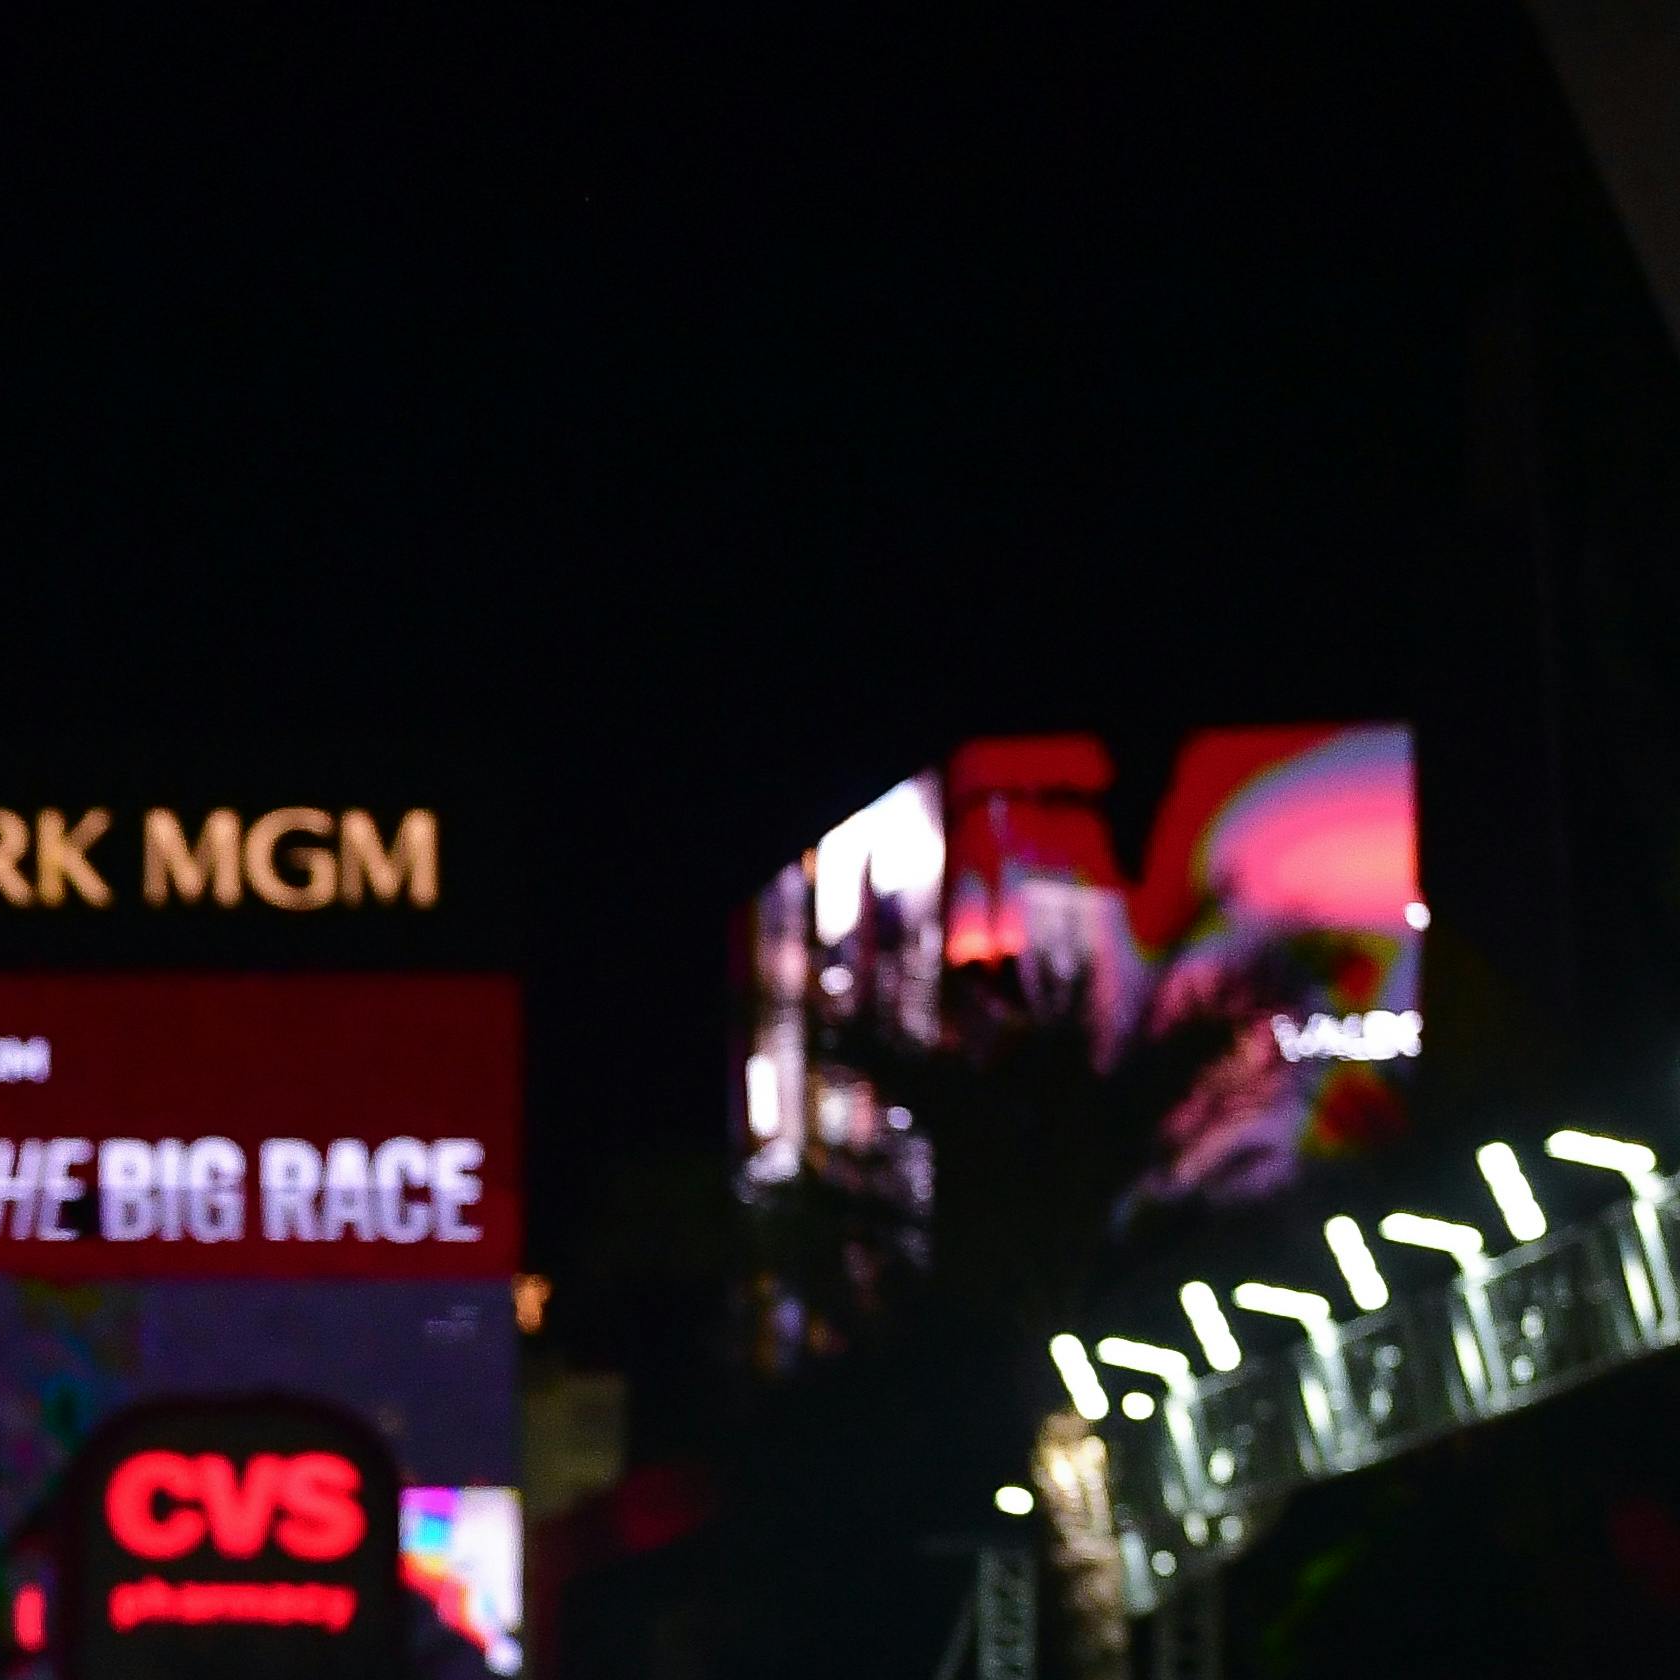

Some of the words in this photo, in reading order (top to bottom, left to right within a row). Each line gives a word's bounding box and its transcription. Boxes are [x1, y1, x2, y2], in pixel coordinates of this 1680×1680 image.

[138, 803, 440, 911] MGM
[98, 1136, 247, 1244] BIG
[257, 1137, 485, 1244] RACE
[104, 1448, 368, 1563] CVS
